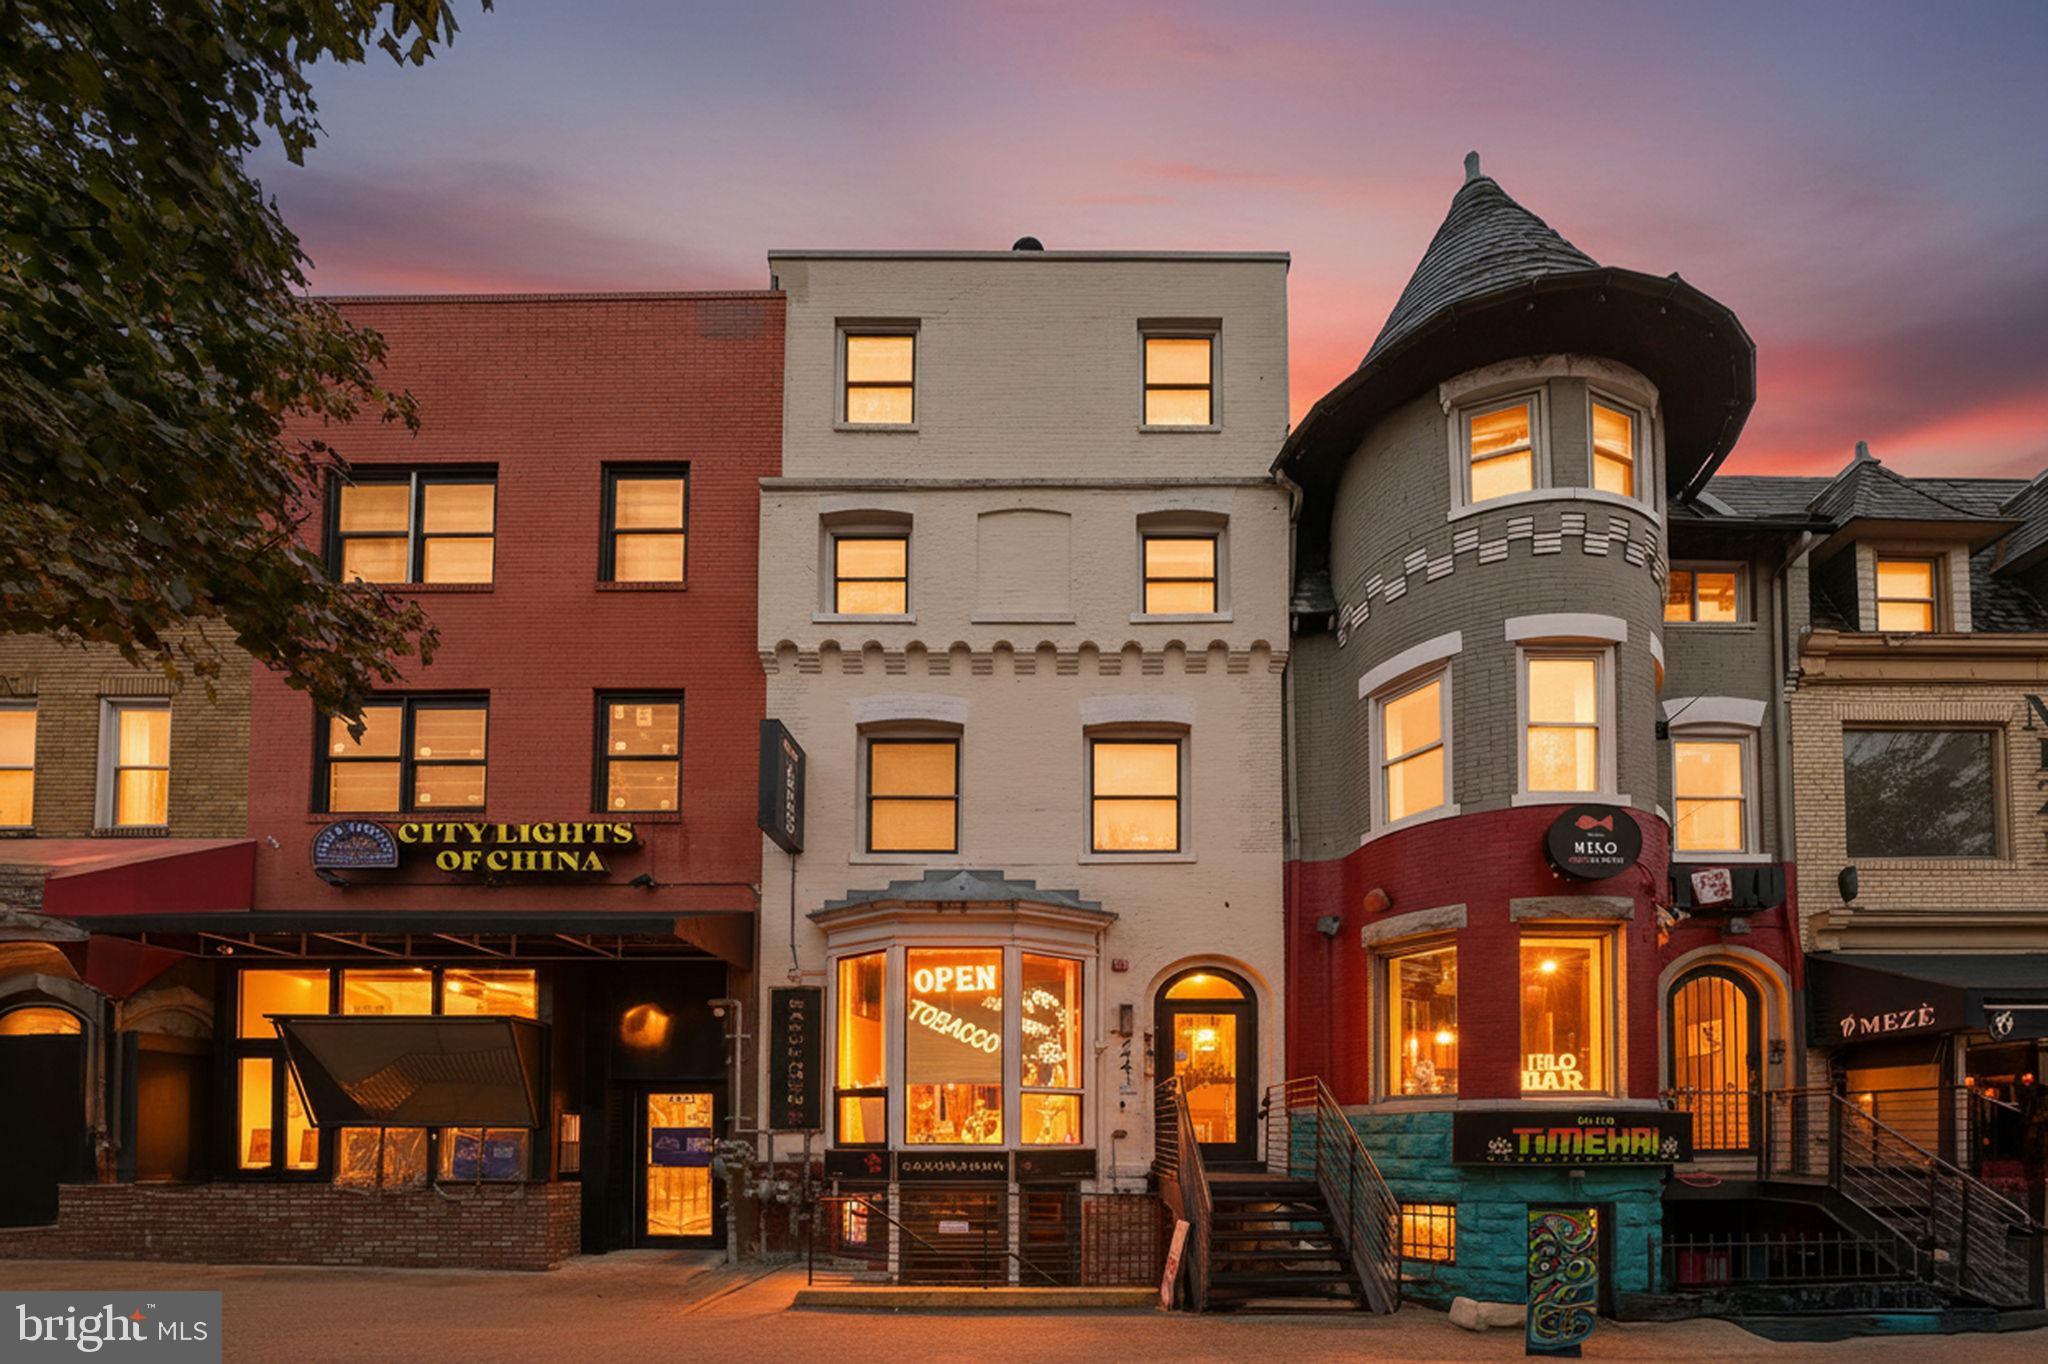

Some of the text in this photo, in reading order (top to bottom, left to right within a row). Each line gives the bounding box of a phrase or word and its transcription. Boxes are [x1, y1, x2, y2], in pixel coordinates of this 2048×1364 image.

[398, 822, 487, 844] CITY
[497, 822, 634, 844] LIGHTS
[435, 850, 606, 872] OF CHINA
[913, 965, 996, 993] OPEN
[908, 999, 1000, 1054] TOBACCO
